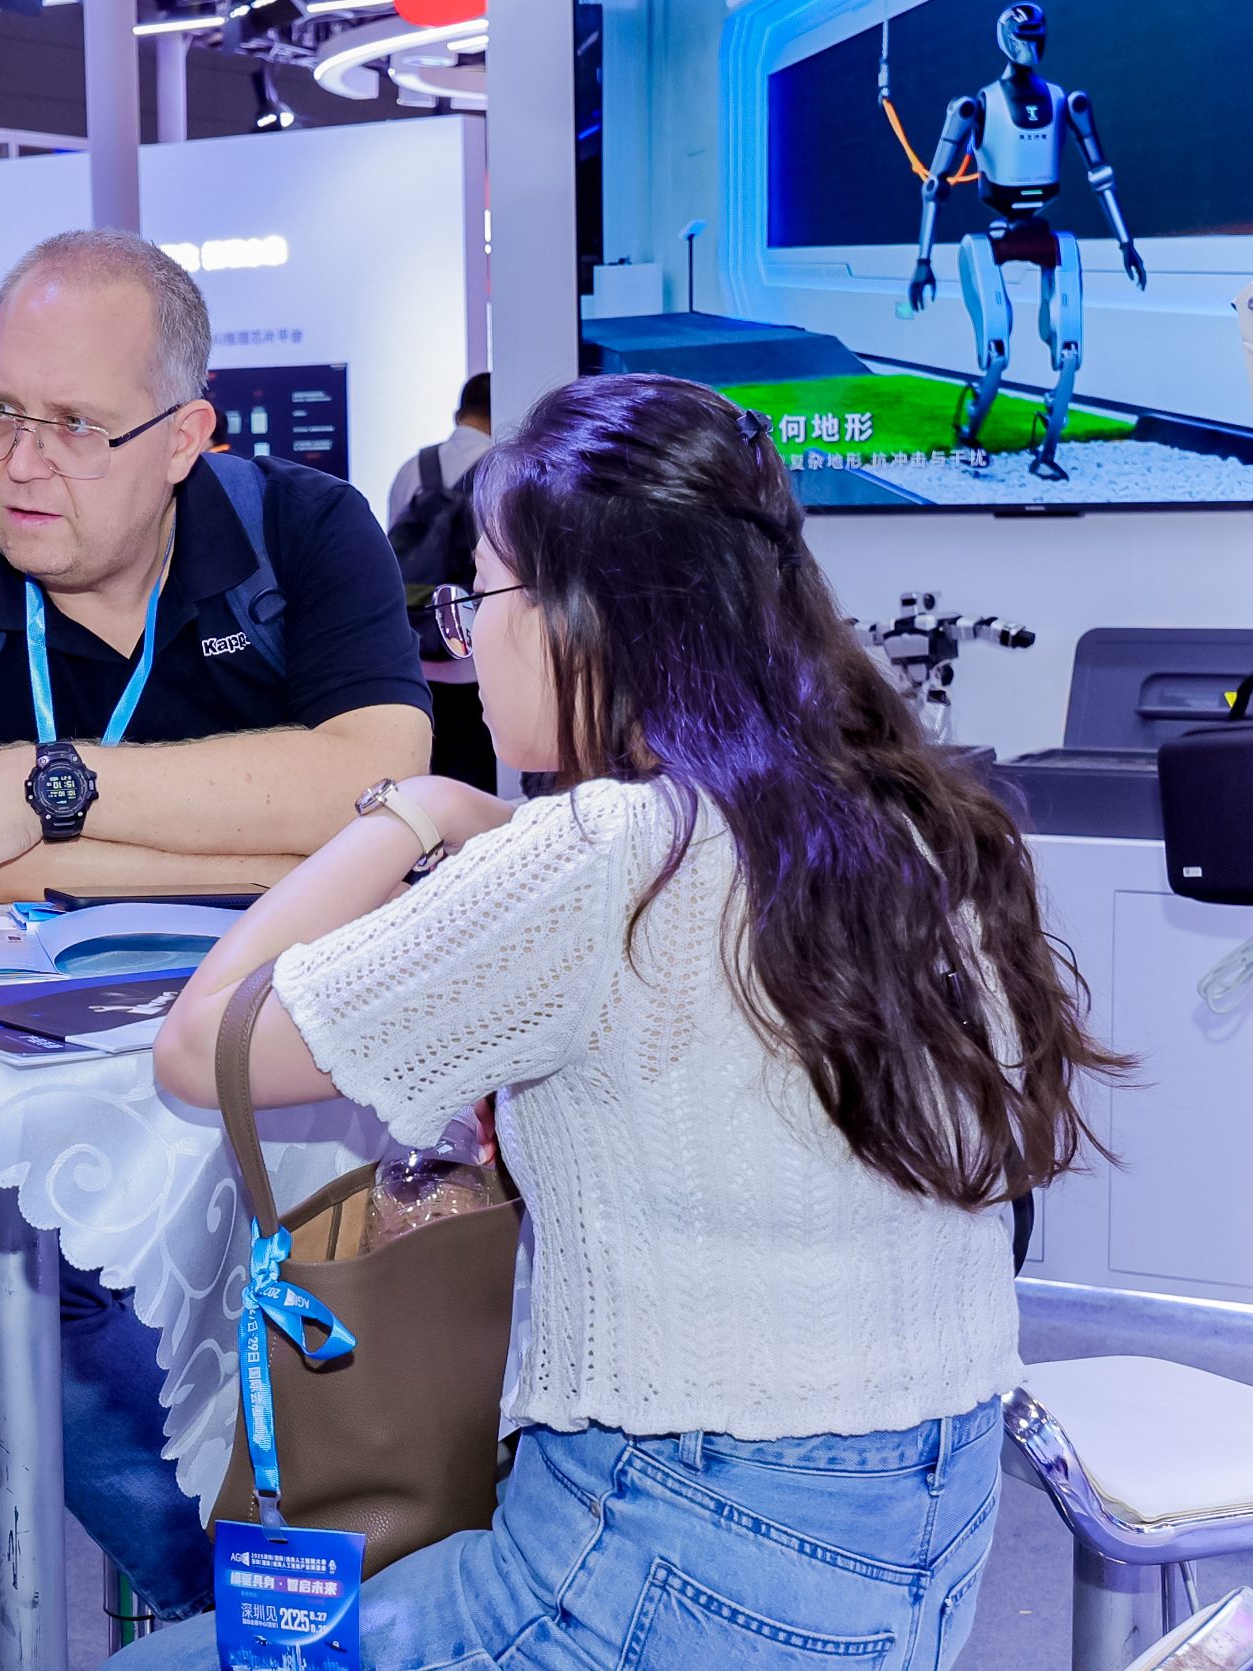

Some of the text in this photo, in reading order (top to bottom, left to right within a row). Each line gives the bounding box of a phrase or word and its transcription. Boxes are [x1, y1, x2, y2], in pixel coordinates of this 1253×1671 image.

[767, 412, 874, 443] 何地形
[241, 1602, 327, 1632] 深圳见 2025 8.27
